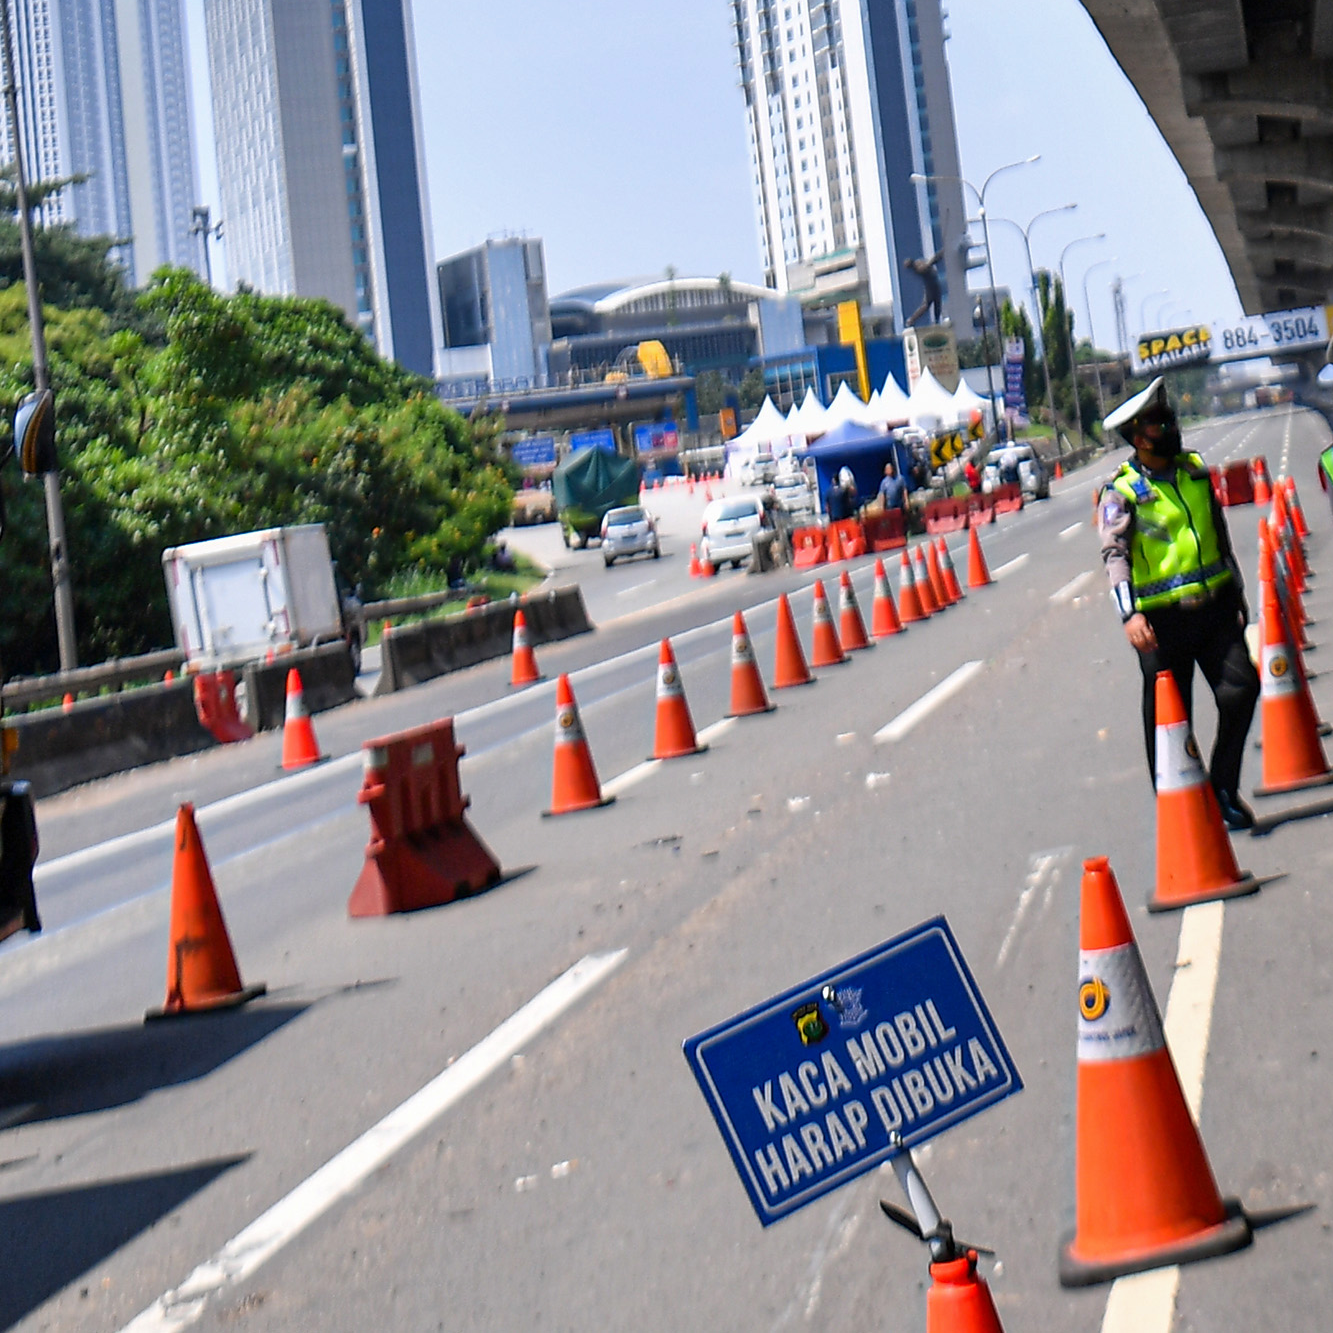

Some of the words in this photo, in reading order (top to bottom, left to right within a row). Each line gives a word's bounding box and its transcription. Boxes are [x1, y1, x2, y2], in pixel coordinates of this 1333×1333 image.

[1223, 316, 1319, 350] 884-3504
[752, 1049, 852, 1133] KACA
[845, 998, 956, 1085] MOBIL
[754, 1099, 868, 1195] HARAP
[870, 1035, 998, 1132] DIBUKA
